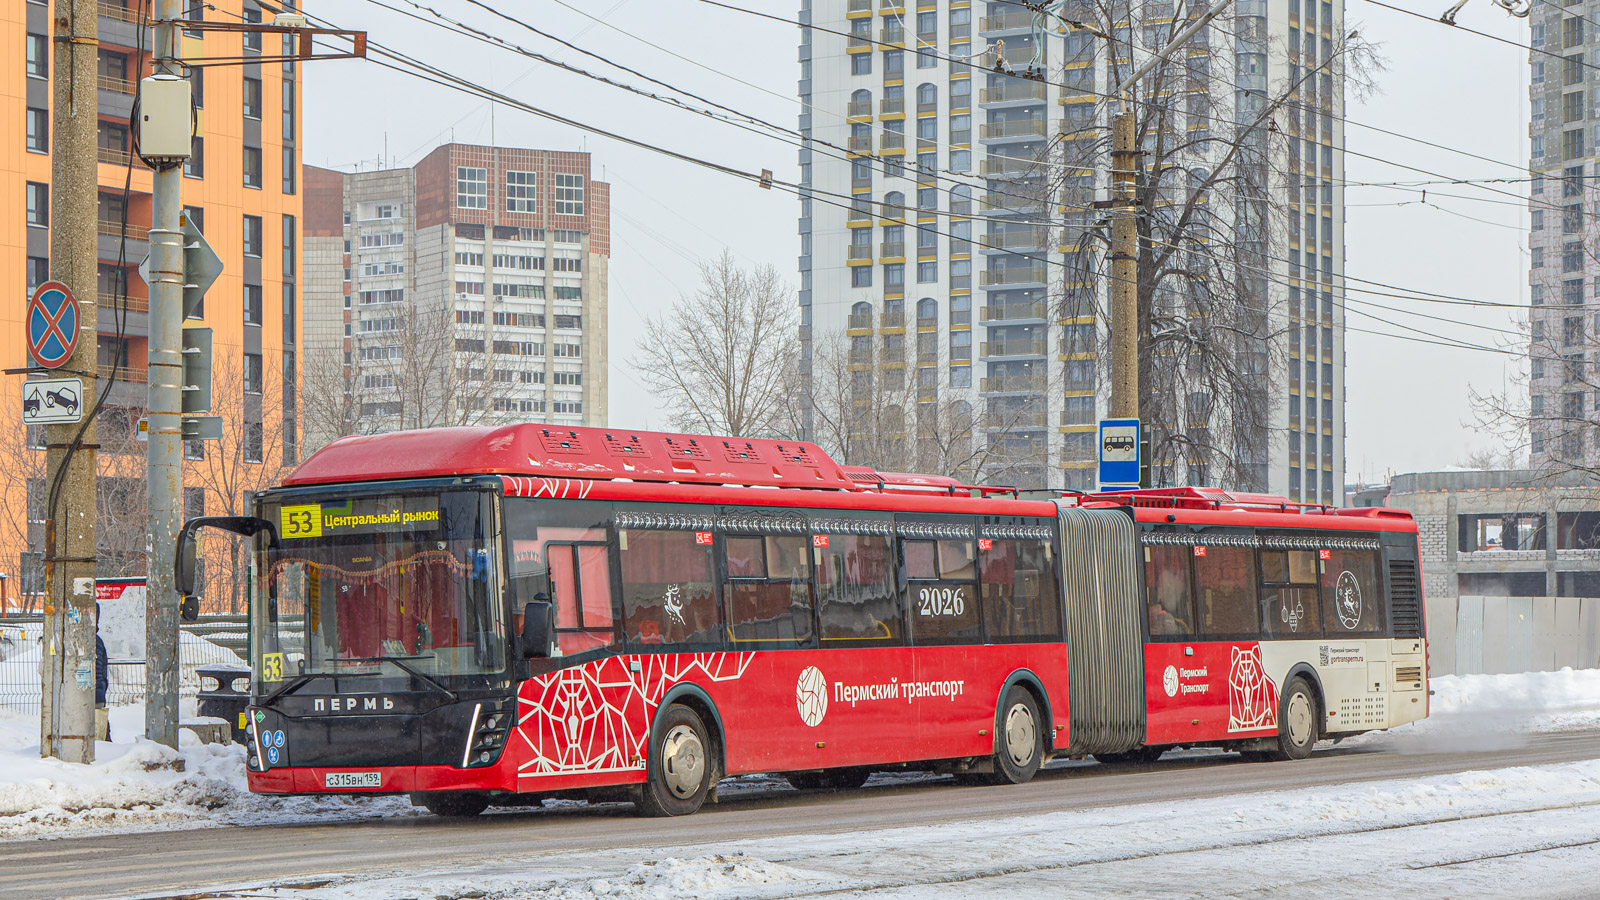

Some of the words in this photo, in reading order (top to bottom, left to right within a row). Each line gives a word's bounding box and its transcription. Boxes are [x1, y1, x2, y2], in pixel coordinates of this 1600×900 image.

[289, 511, 313, 534] 53
[324, 509, 400, 530] Центральный
[402, 510, 439, 524] рынок
[919, 587, 965, 617] 2026
[1330, 656, 1363, 664] gortransperm.ru
[264, 656, 281, 680] 53
[1180, 666, 1207, 680] Пермский
[834, 677, 898, 708] Пермский
[901, 680, 964, 704] транспорт
[1180, 683, 1209, 696] Транспорт
[314, 697, 394, 711] ПЕРМЬ
[364, 773, 378, 782] 159
